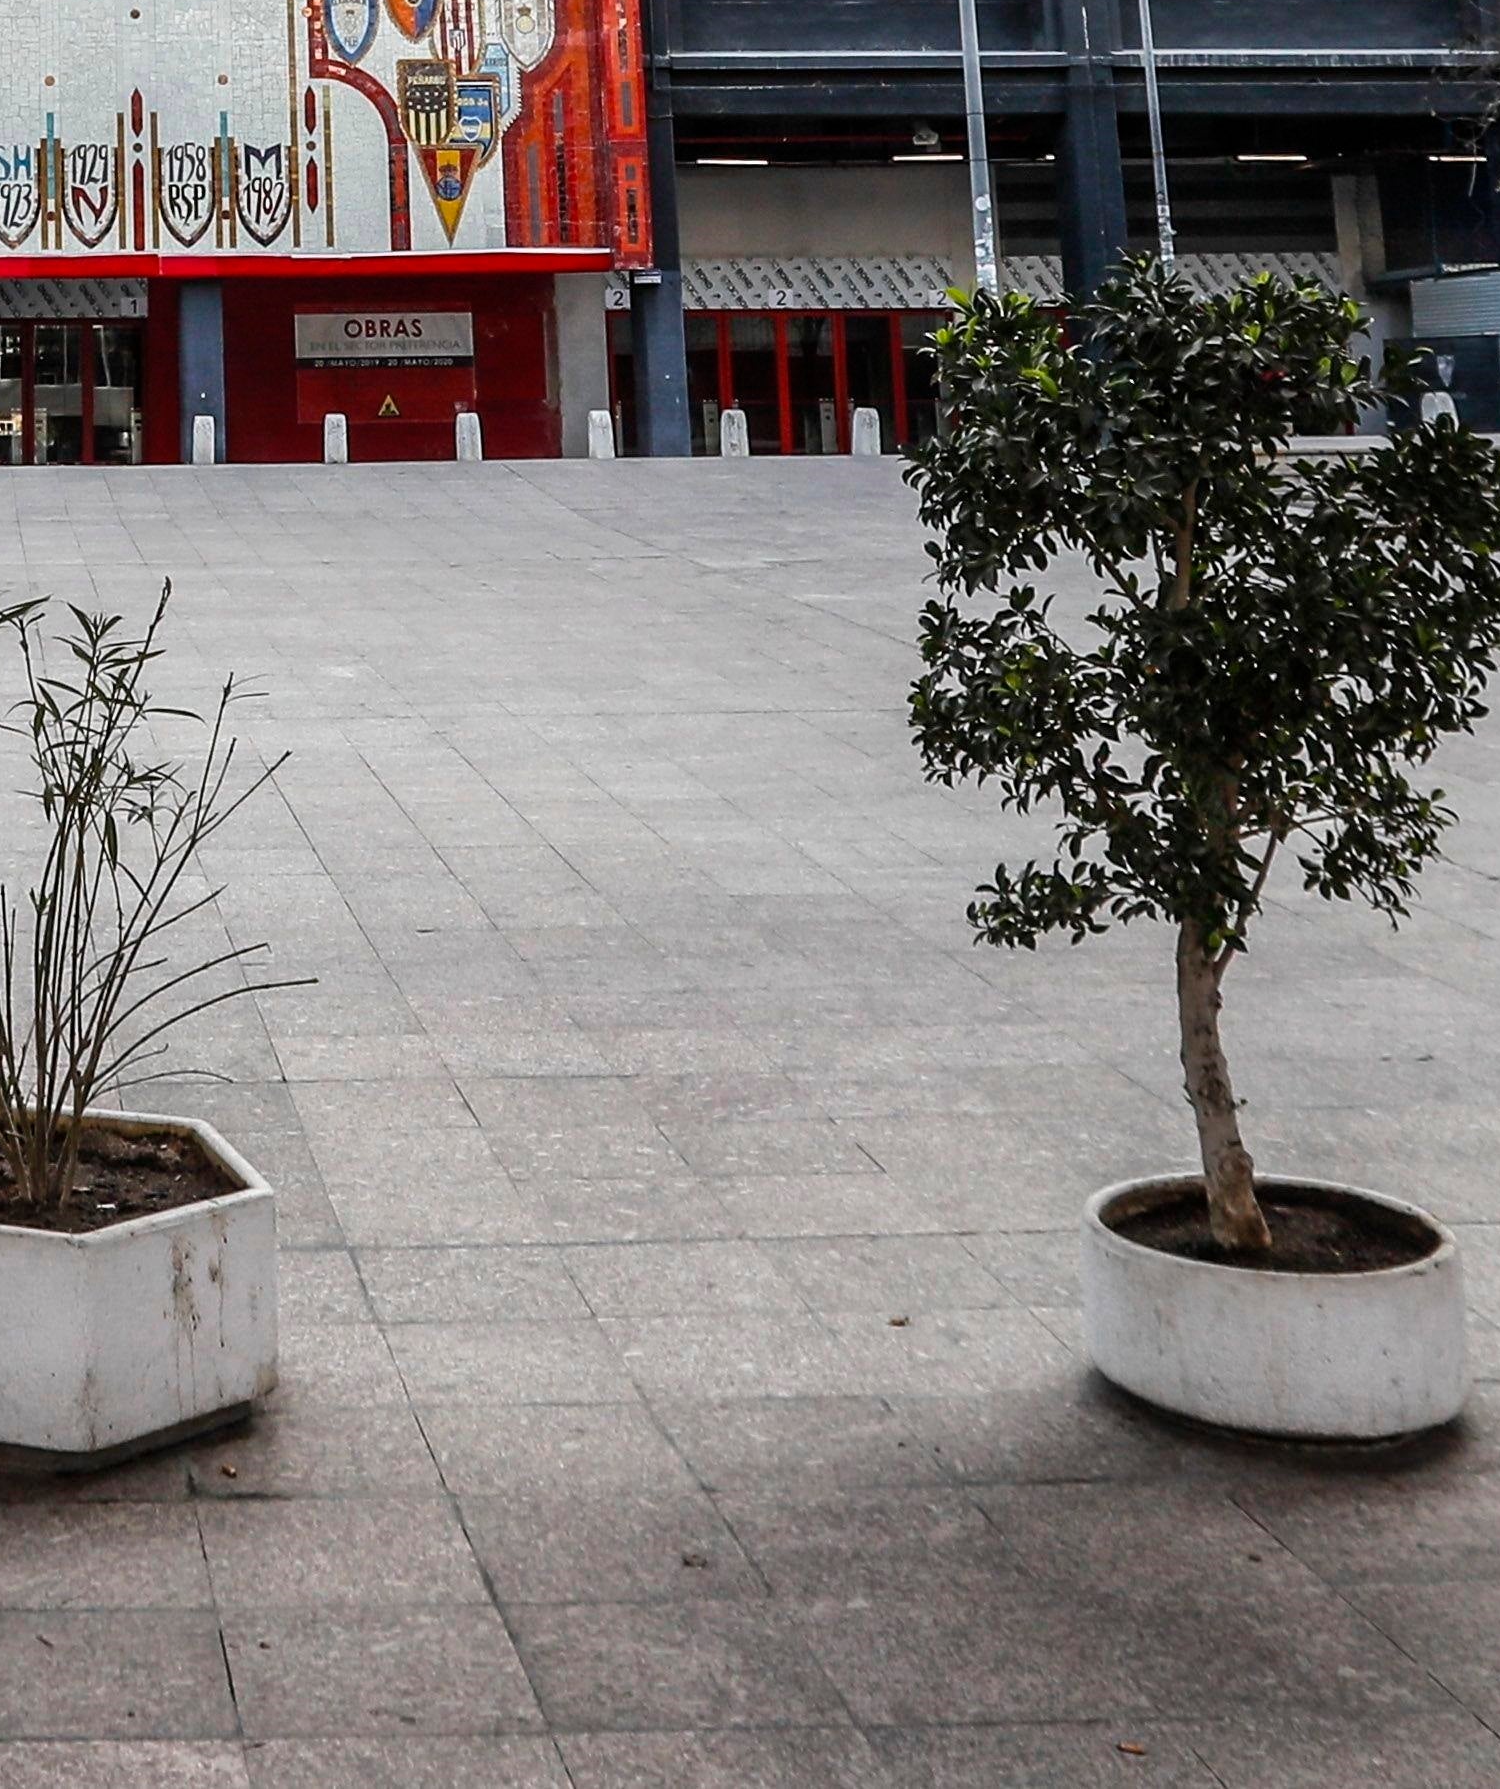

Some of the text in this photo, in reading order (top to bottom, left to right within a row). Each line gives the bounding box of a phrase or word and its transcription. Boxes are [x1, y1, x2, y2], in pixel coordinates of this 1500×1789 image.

[69, 144, 108, 185] 1929
[166, 142, 206, 183] 1958
[243, 143, 282, 180] M
[71, 185, 108, 226] N
[167, 184, 206, 227] RSP
[243, 176, 284, 225] 1982
[613, 291, 624, 306] 2
[776, 291, 787, 306] 2
[344, 319, 422, 338] OBRAS
